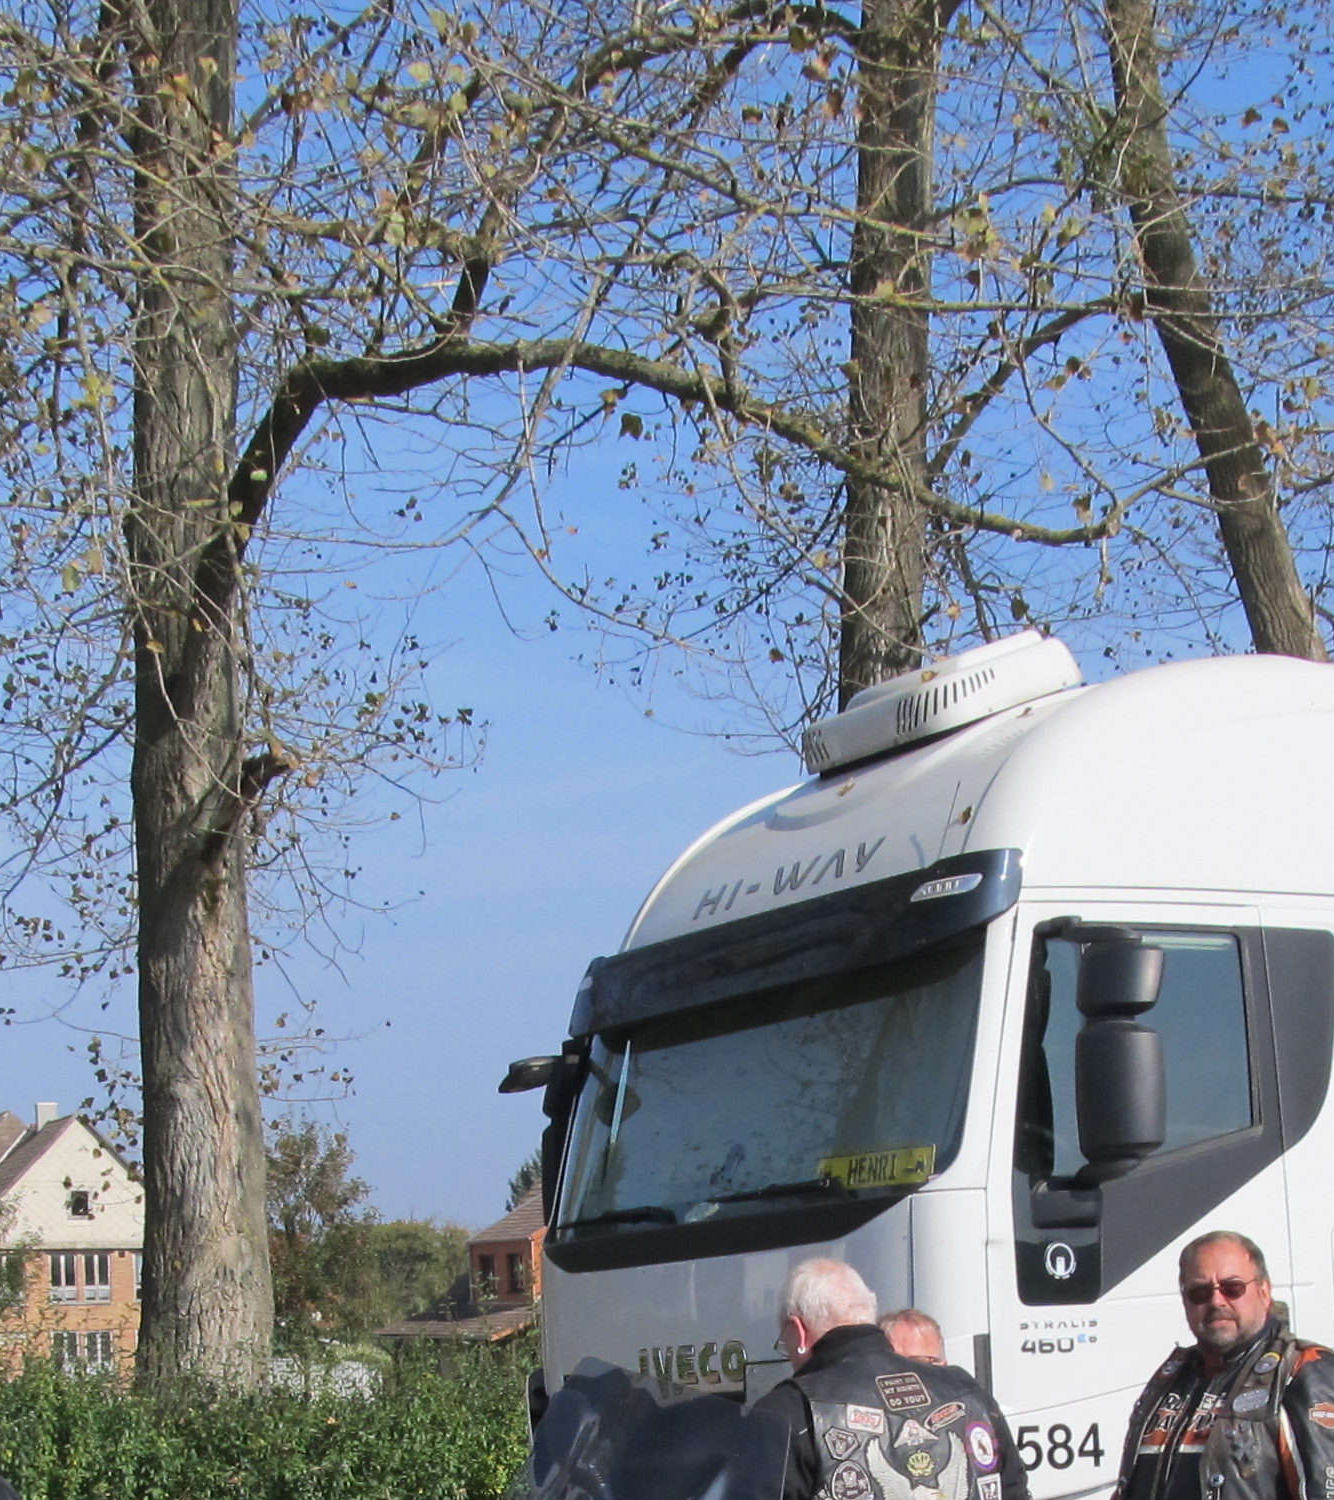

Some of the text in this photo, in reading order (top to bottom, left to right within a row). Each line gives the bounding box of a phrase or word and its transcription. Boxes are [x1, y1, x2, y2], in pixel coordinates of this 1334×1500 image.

[693, 836, 886, 920] HI-WAY
[848, 1153, 896, 1184] HENRI
[1019, 1318, 1098, 1331] STRALIS
[639, 1340, 748, 1394] IVECO
[1017, 1422, 1105, 1472] 584
